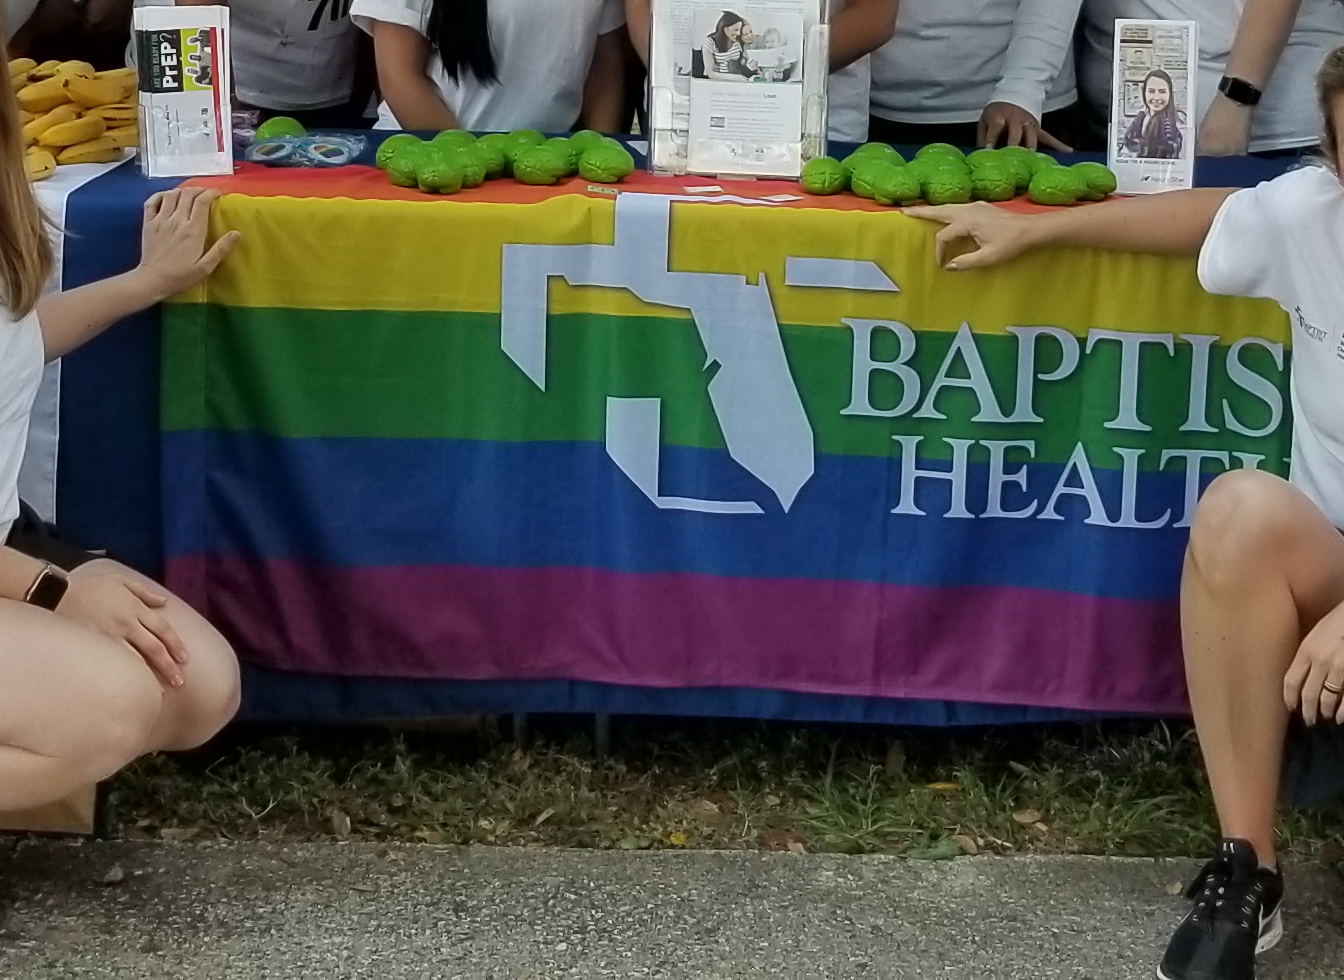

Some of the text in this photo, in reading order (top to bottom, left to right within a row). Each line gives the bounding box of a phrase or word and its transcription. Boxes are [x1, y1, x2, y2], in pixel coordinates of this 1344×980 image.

[159, 32, 179, 88] PrEP?
[839, 317, 1285, 438] BAPTIS
[889, 435, 1292, 529] HEALT
